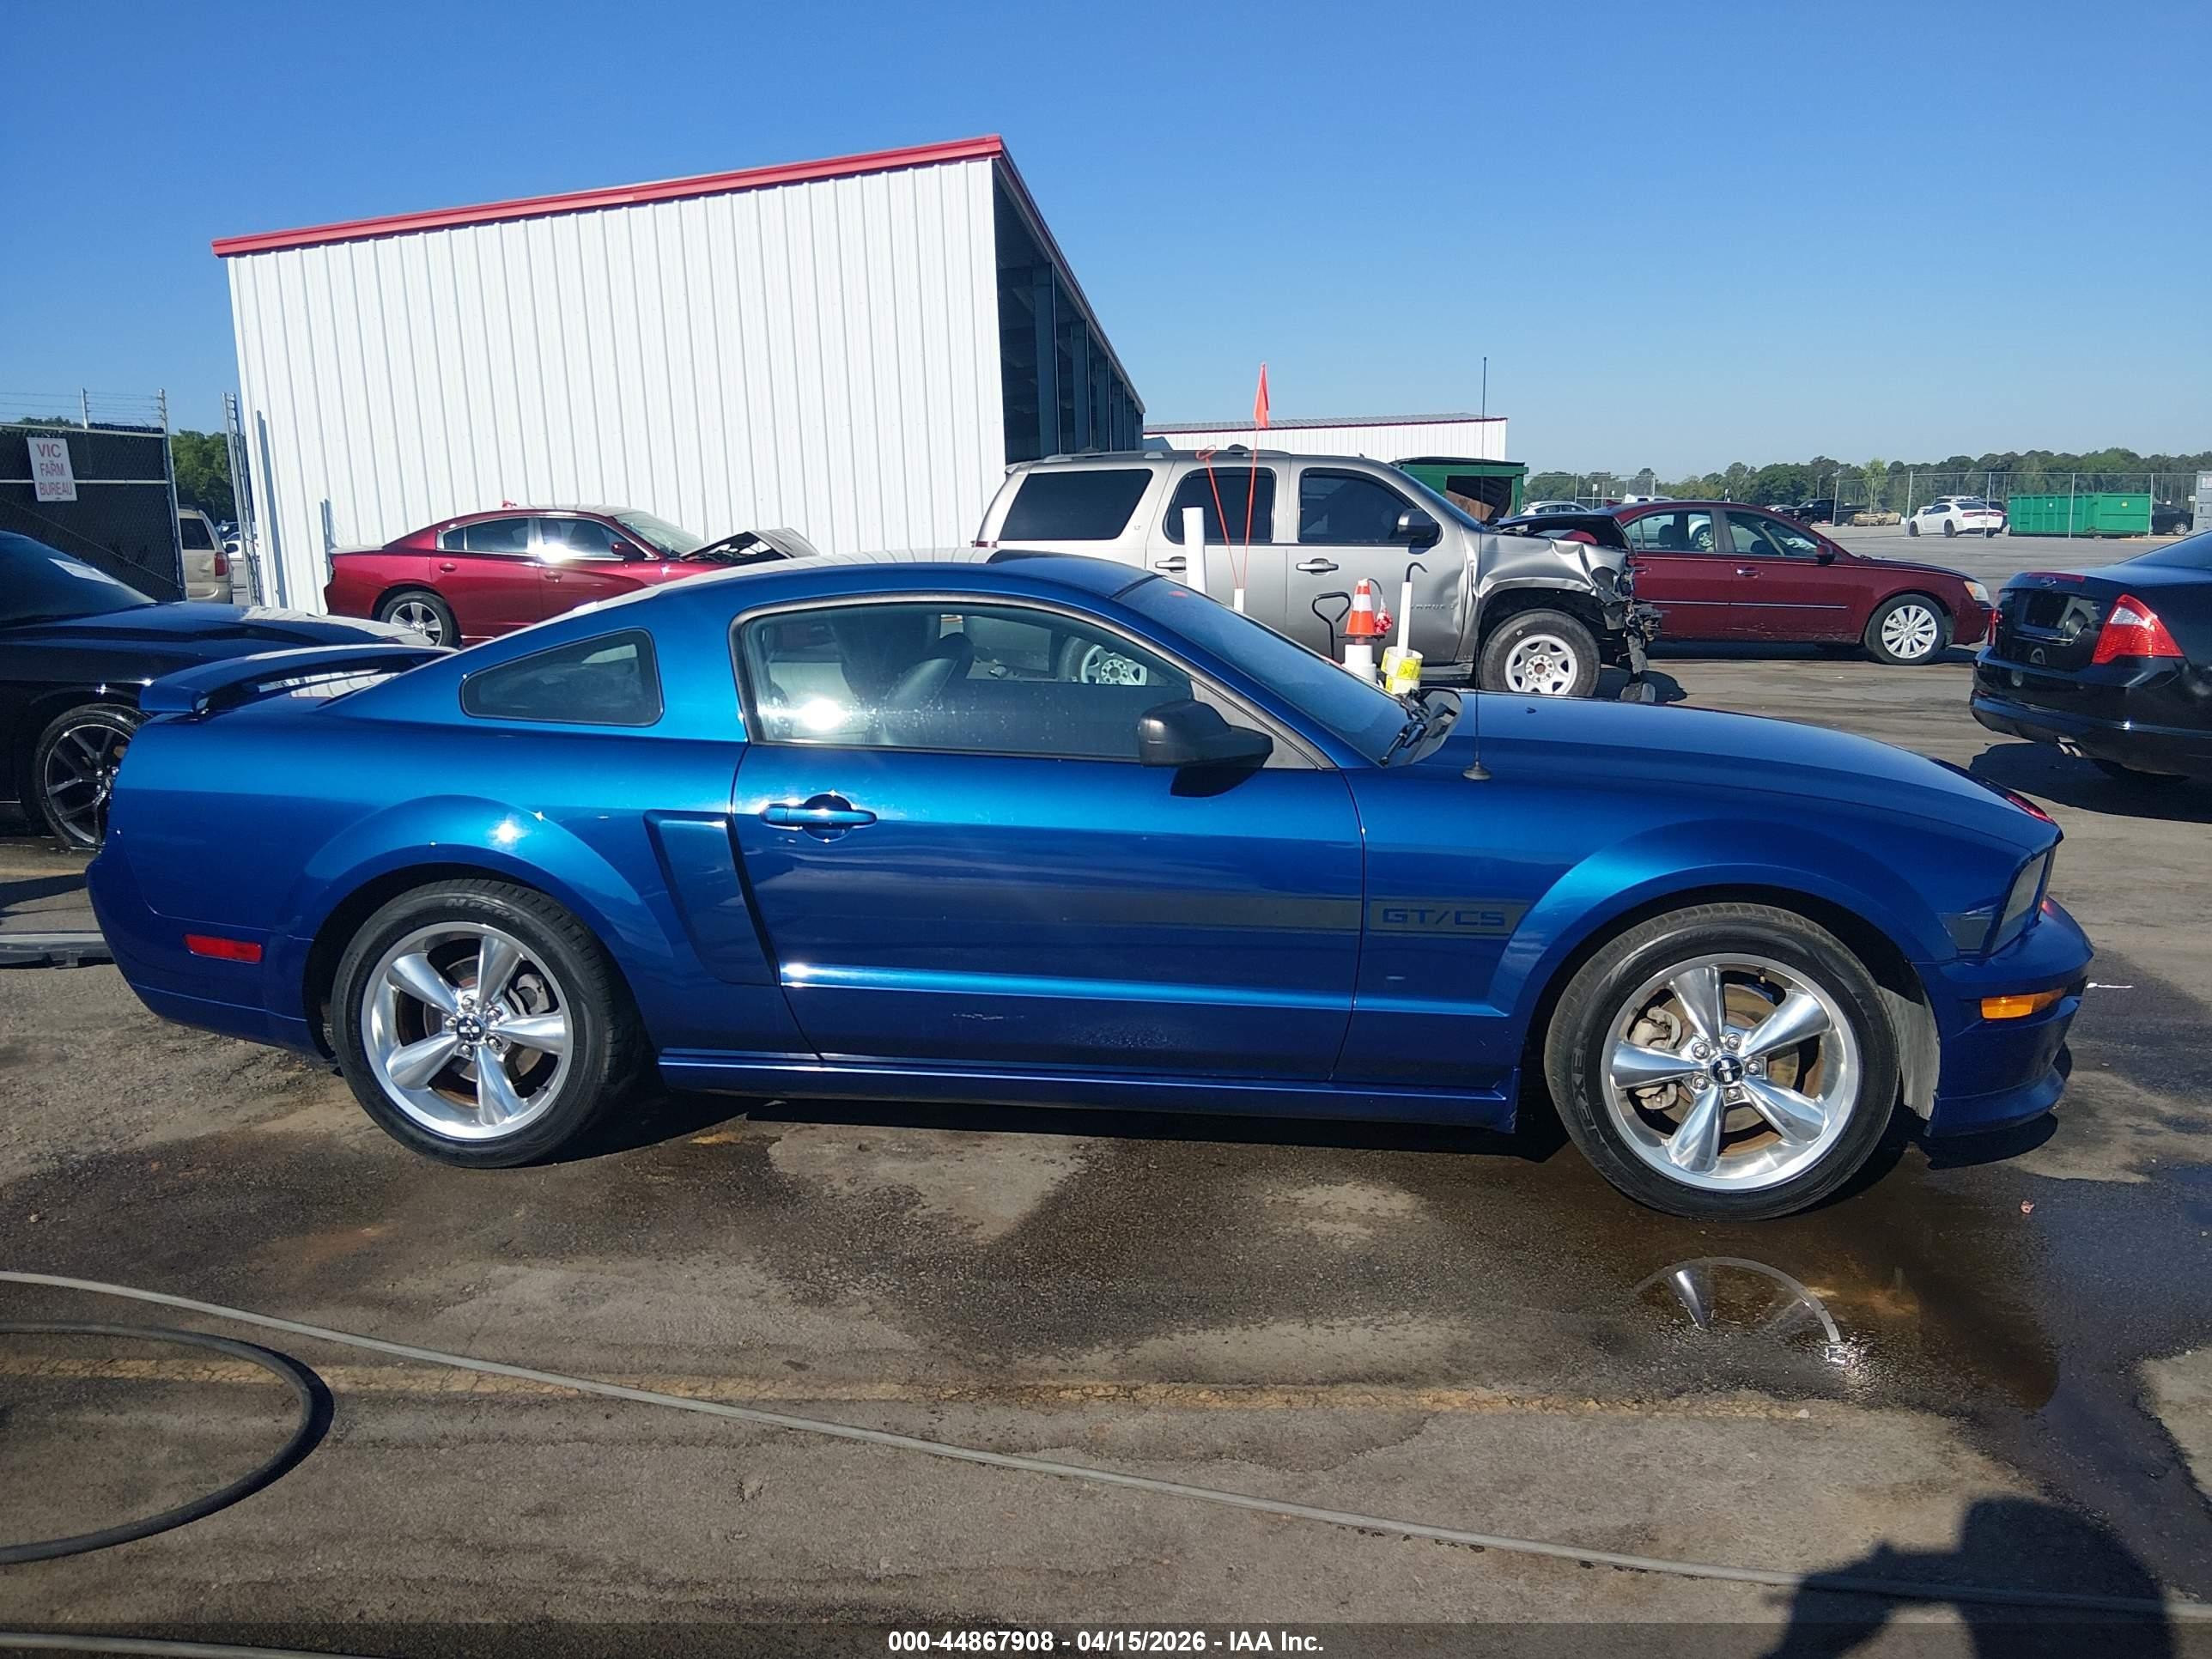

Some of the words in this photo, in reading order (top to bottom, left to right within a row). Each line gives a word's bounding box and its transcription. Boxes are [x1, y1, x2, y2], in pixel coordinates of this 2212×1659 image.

[36, 443, 62, 459] VIC
[40, 463, 66, 477] FARM
[39, 481, 73, 495] BUREAU
[1382, 908, 1506, 927] GT/CS
